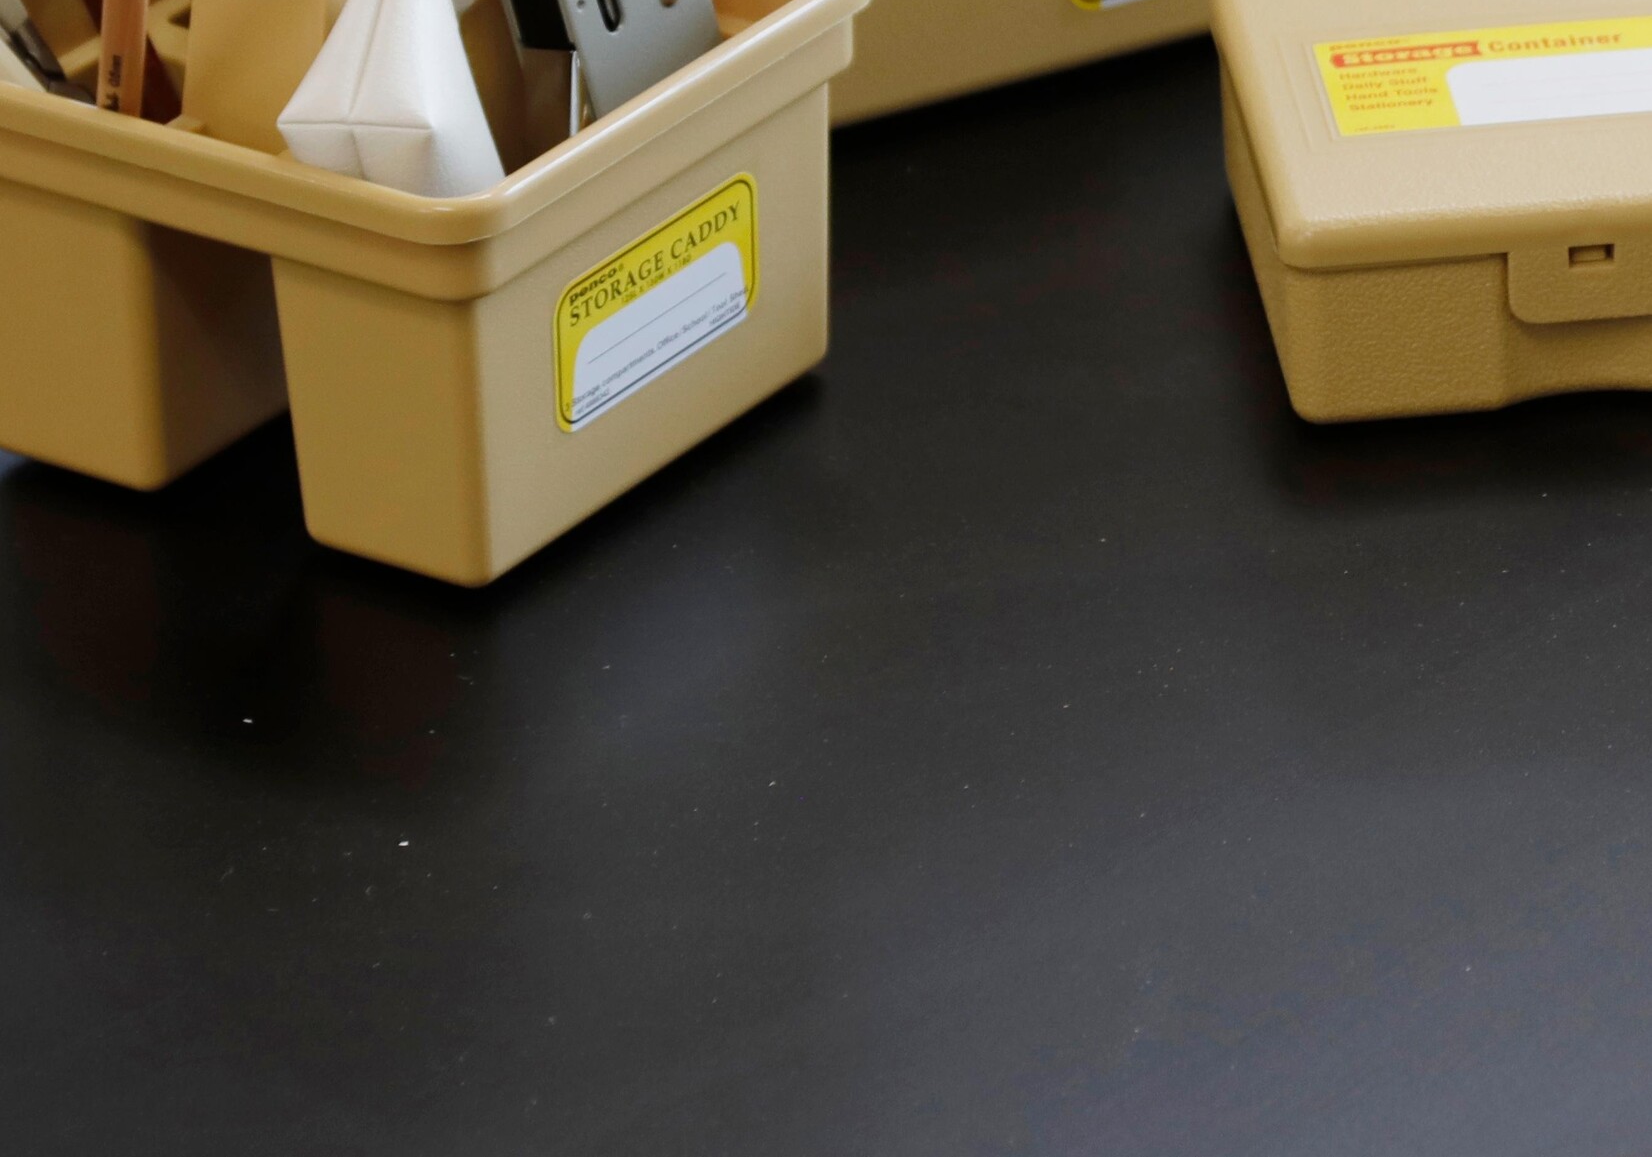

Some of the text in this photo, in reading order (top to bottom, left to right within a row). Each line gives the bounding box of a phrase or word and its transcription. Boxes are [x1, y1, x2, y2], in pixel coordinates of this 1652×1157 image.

[1343, 32, 1623, 65] Storage Container
[1339, 67, 1418, 81] Hardware
[1348, 98, 1433, 112] Stationery
[569, 250, 664, 328] STORAGE
[669, 200, 740, 261] CADDY
